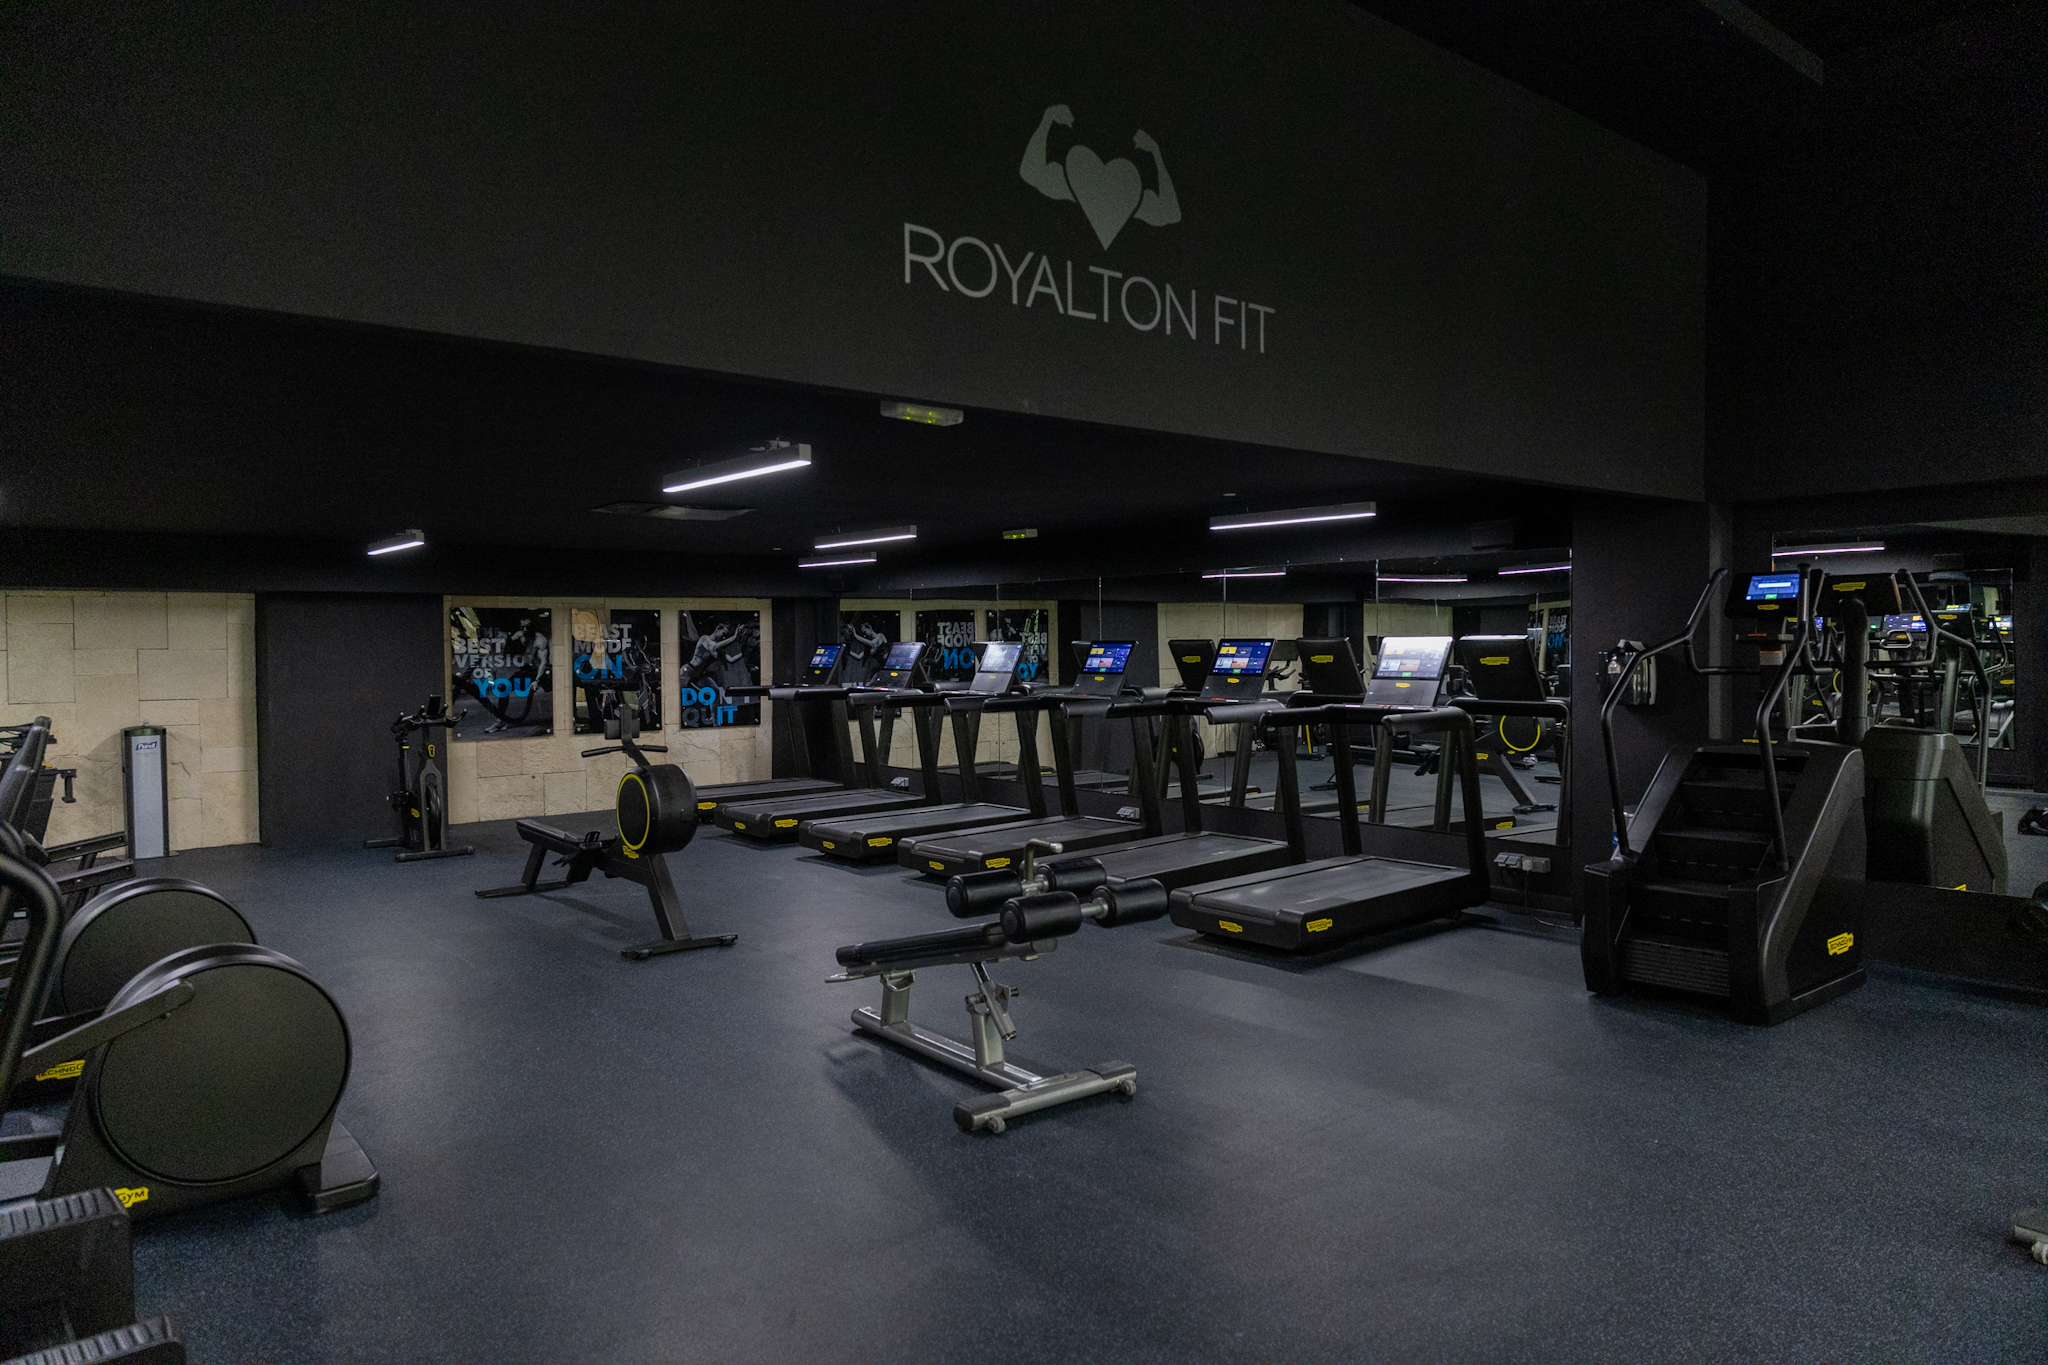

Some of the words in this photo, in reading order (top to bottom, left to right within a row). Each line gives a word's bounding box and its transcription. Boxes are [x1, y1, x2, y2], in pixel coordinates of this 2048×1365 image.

[904, 222, 1196, 340] ROYALTON
[1215, 294, 1275, 353] FIT
[575, 623, 632, 640] BEAST
[453, 637, 505, 654] BEST
[574, 638, 632, 654] MODE
[453, 654, 534, 668] VERSIO
[573, 654, 623, 680] ON
[473, 677, 532, 699] YOU
[681, 705, 738, 727] QUIT
